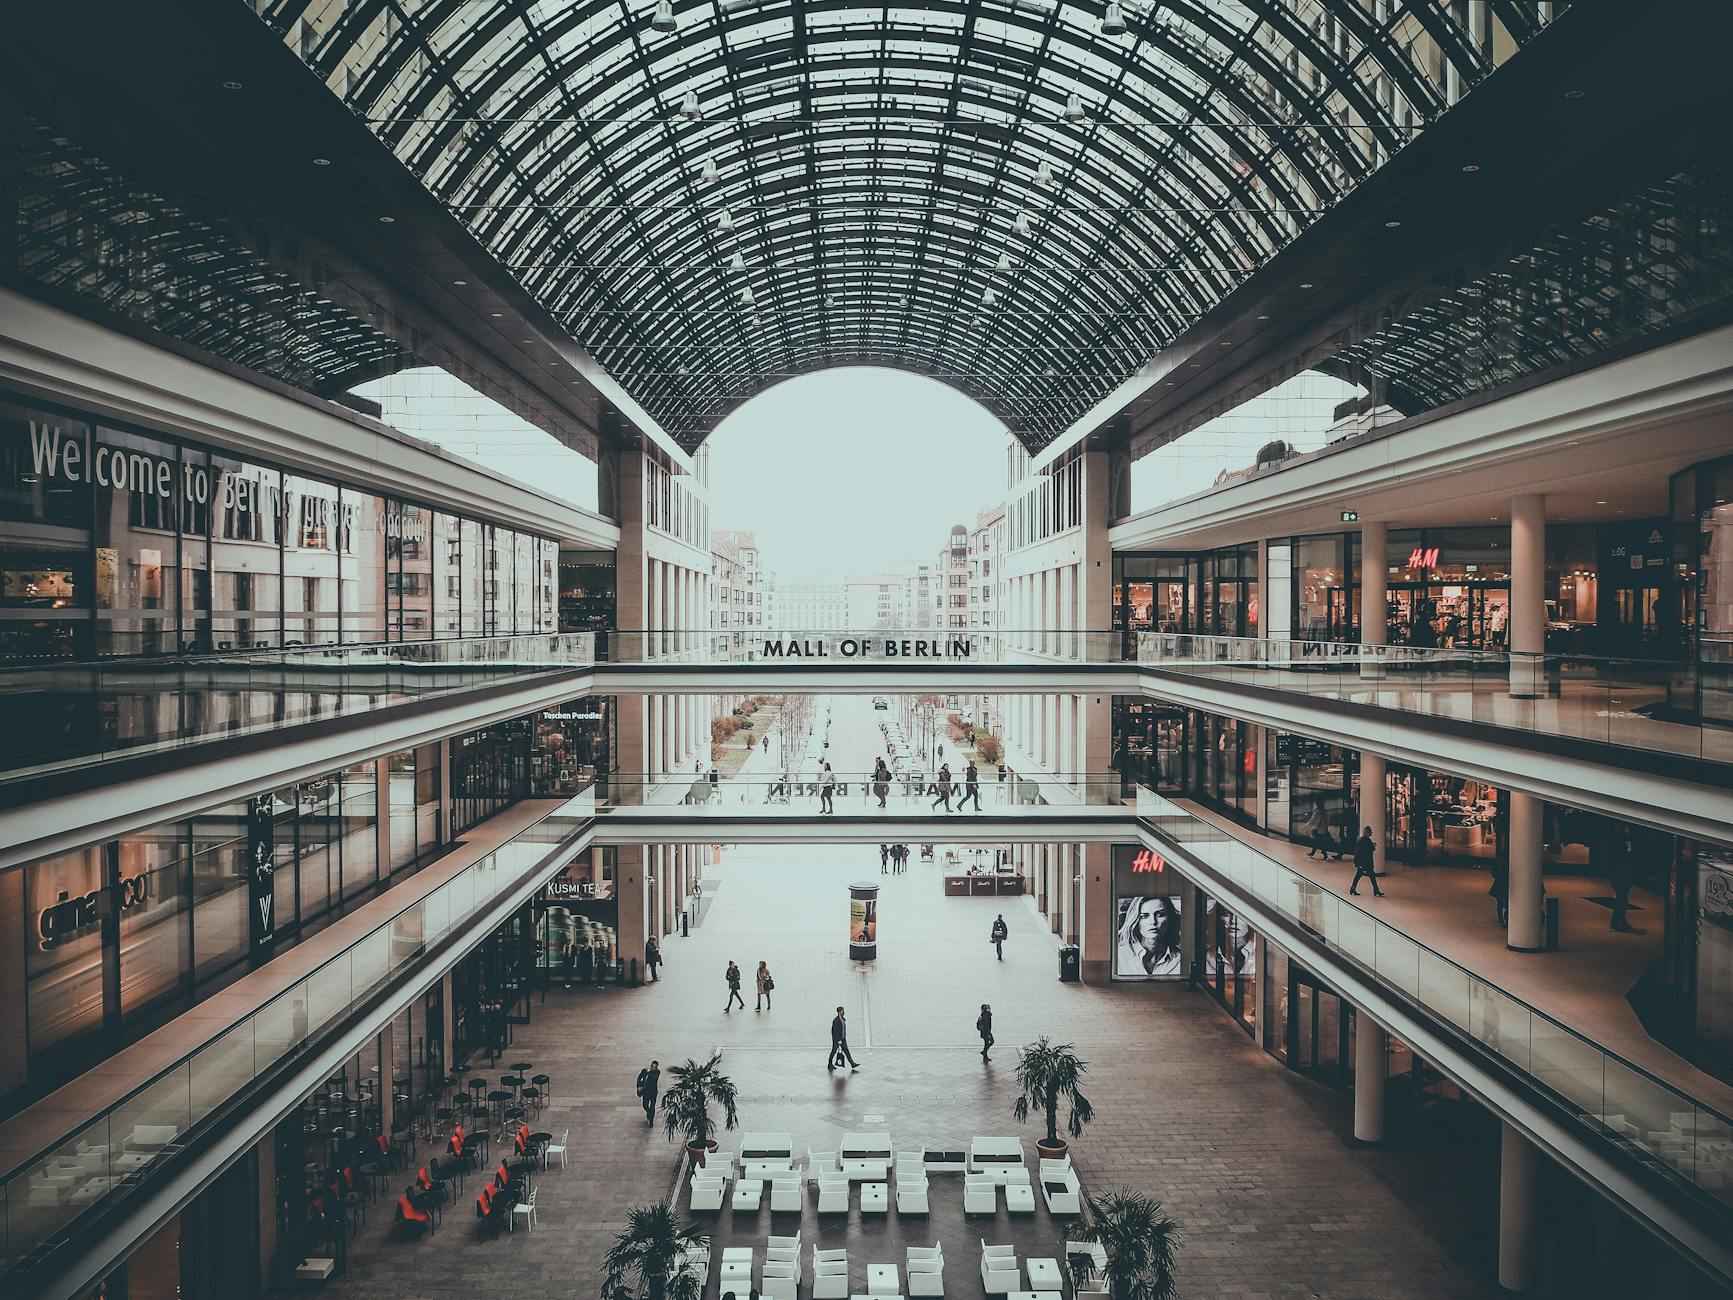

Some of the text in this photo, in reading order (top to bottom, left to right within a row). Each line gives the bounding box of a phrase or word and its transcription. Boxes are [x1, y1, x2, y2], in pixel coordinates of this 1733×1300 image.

[29, 420, 171, 498] Welcome
[184, 462, 208, 504] to
[1408, 547, 1440, 569] H&M
[763, 639, 970, 657] MALL OF BERLIN
[1131, 850, 1166, 873] H&M
[547, 882, 603, 896] KUSMI TEA
